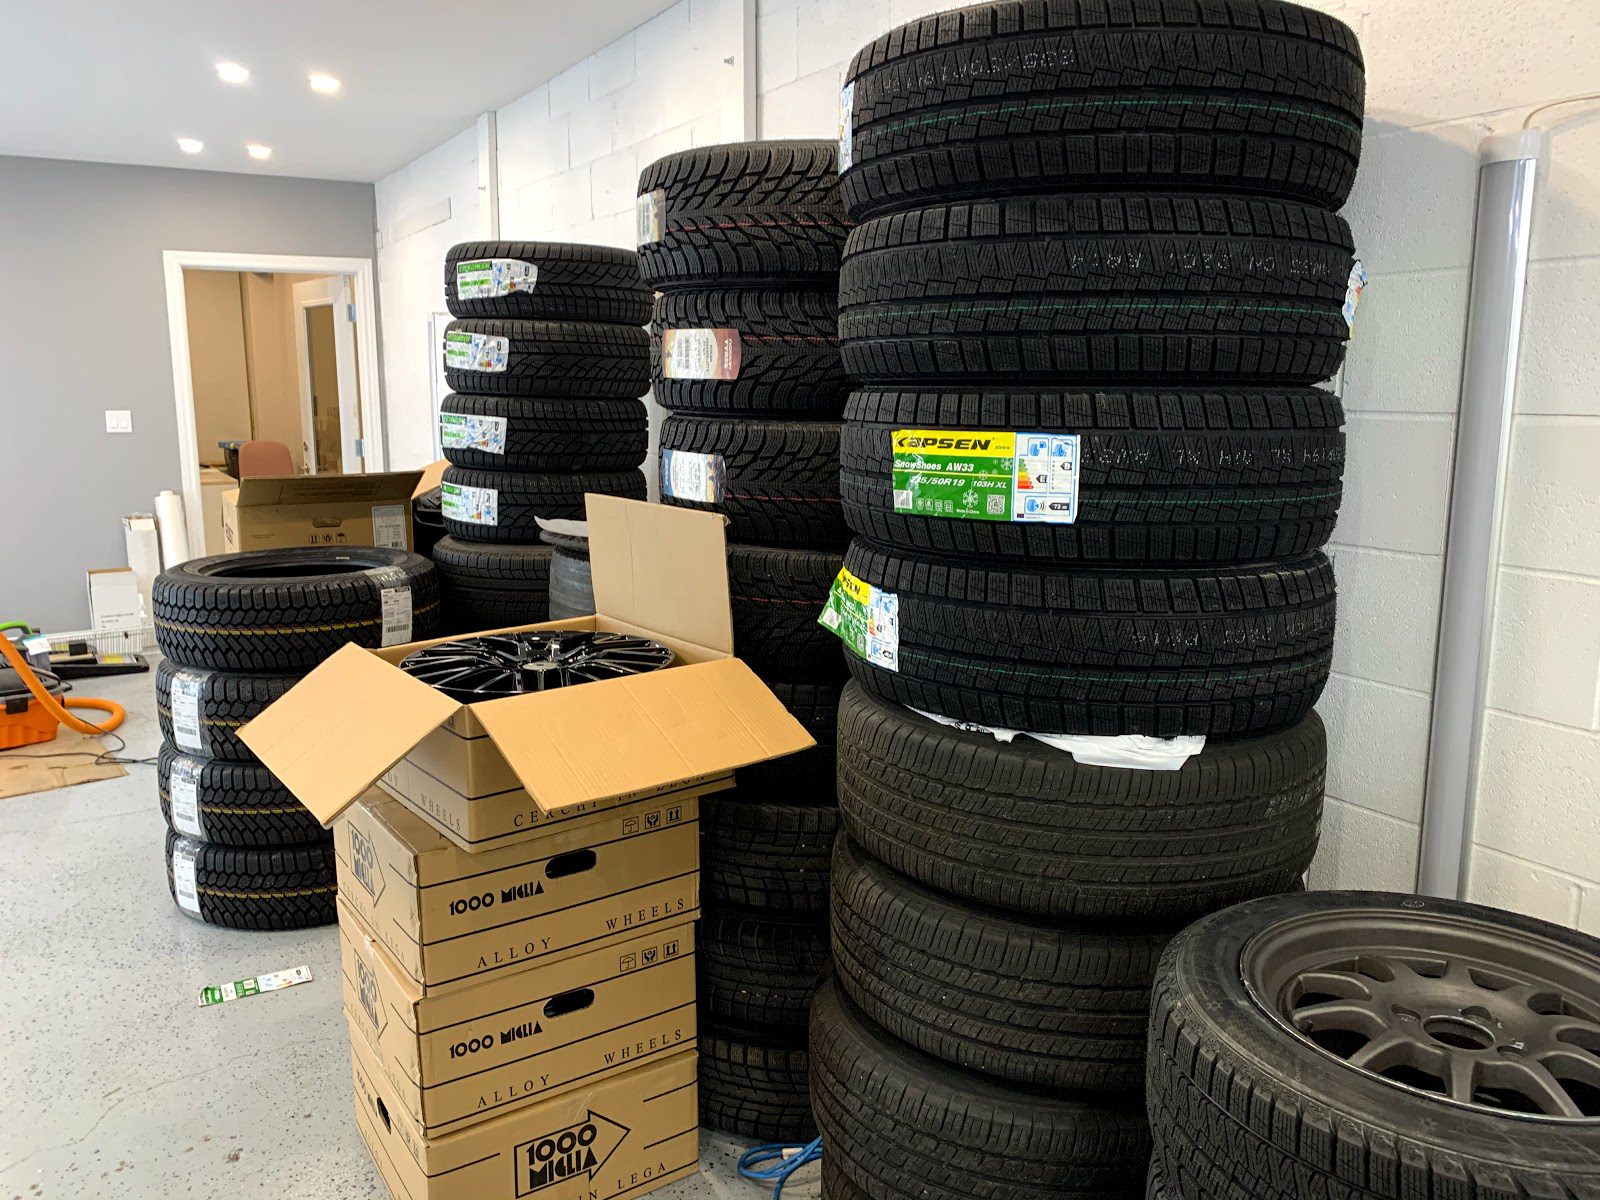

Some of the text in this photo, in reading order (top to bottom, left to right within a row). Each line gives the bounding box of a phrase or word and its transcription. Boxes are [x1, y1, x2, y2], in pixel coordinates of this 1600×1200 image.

[894, 459, 974, 472] SnowShoes AW33
[972, 480, 994, 488] 103H
[995, 481, 1007, 489] XL
[420, 792, 461, 831] WHEELS
[351, 829, 374, 869] 1000
[449, 881, 545, 915] 1000 MIGLIA
[477, 898, 684, 968] ALLOY WHEELS
[449, 1020, 543, 1059] 1000 MIGLIA
[478, 1029, 682, 1108] ALLOY WHEELS
[526, 1123, 597, 1166] 1000
[529, 1146, 598, 1189] MIGLIA
[617, 1162, 666, 1190] LEGA
